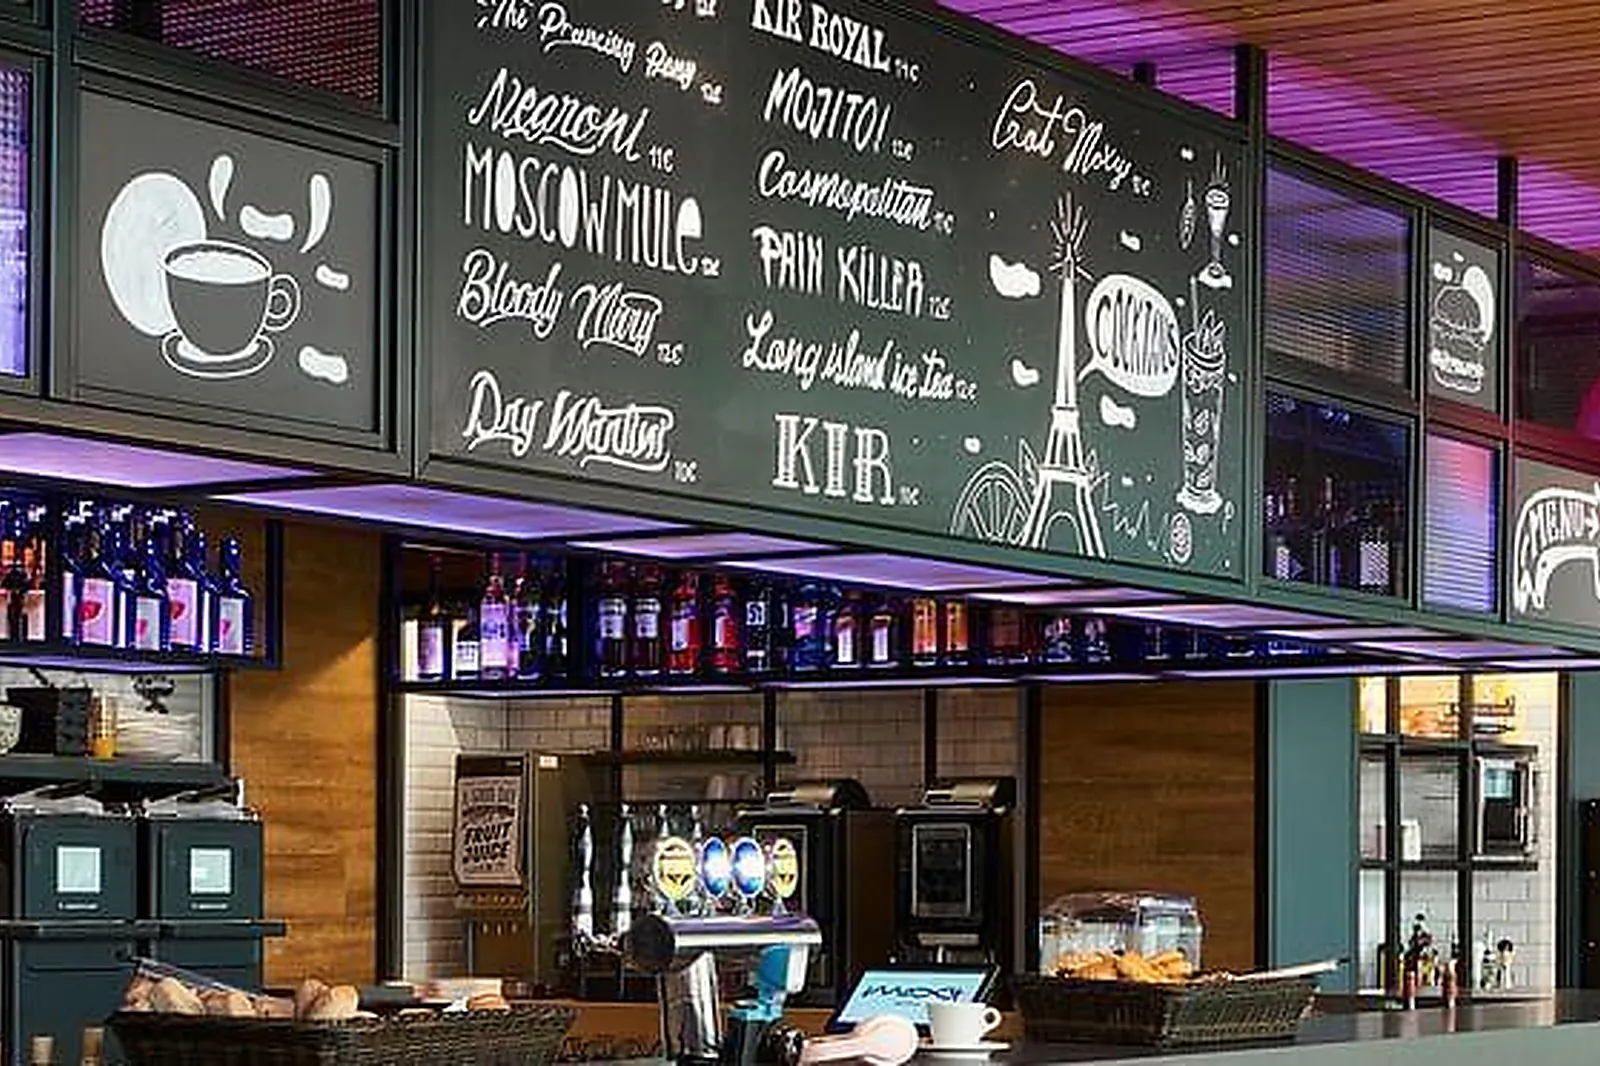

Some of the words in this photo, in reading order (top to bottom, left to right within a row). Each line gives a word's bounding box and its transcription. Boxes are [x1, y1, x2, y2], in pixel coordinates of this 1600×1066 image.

[538, 2, 636, 74] Prancing
[752, 0, 803, 42] KIR
[809, 3, 891, 73] ROYAL
[468, 67, 649, 162] Negroni
[1061, 107, 1132, 190] Moxy
[465, 141, 611, 254] MOSCOW
[758, 150, 935, 231] Cosmopolitan
[457, 249, 564, 339] Bloody
[569, 282, 663, 358] Mary
[743, 309, 823, 391] Long
[462, 371, 544, 457] Dry
[542, 390, 675, 472] Martini
[772, 413, 896, 506] KIR
[462, 820, 513, 846] FRUIT
[462, 840, 511, 864] JUICE
